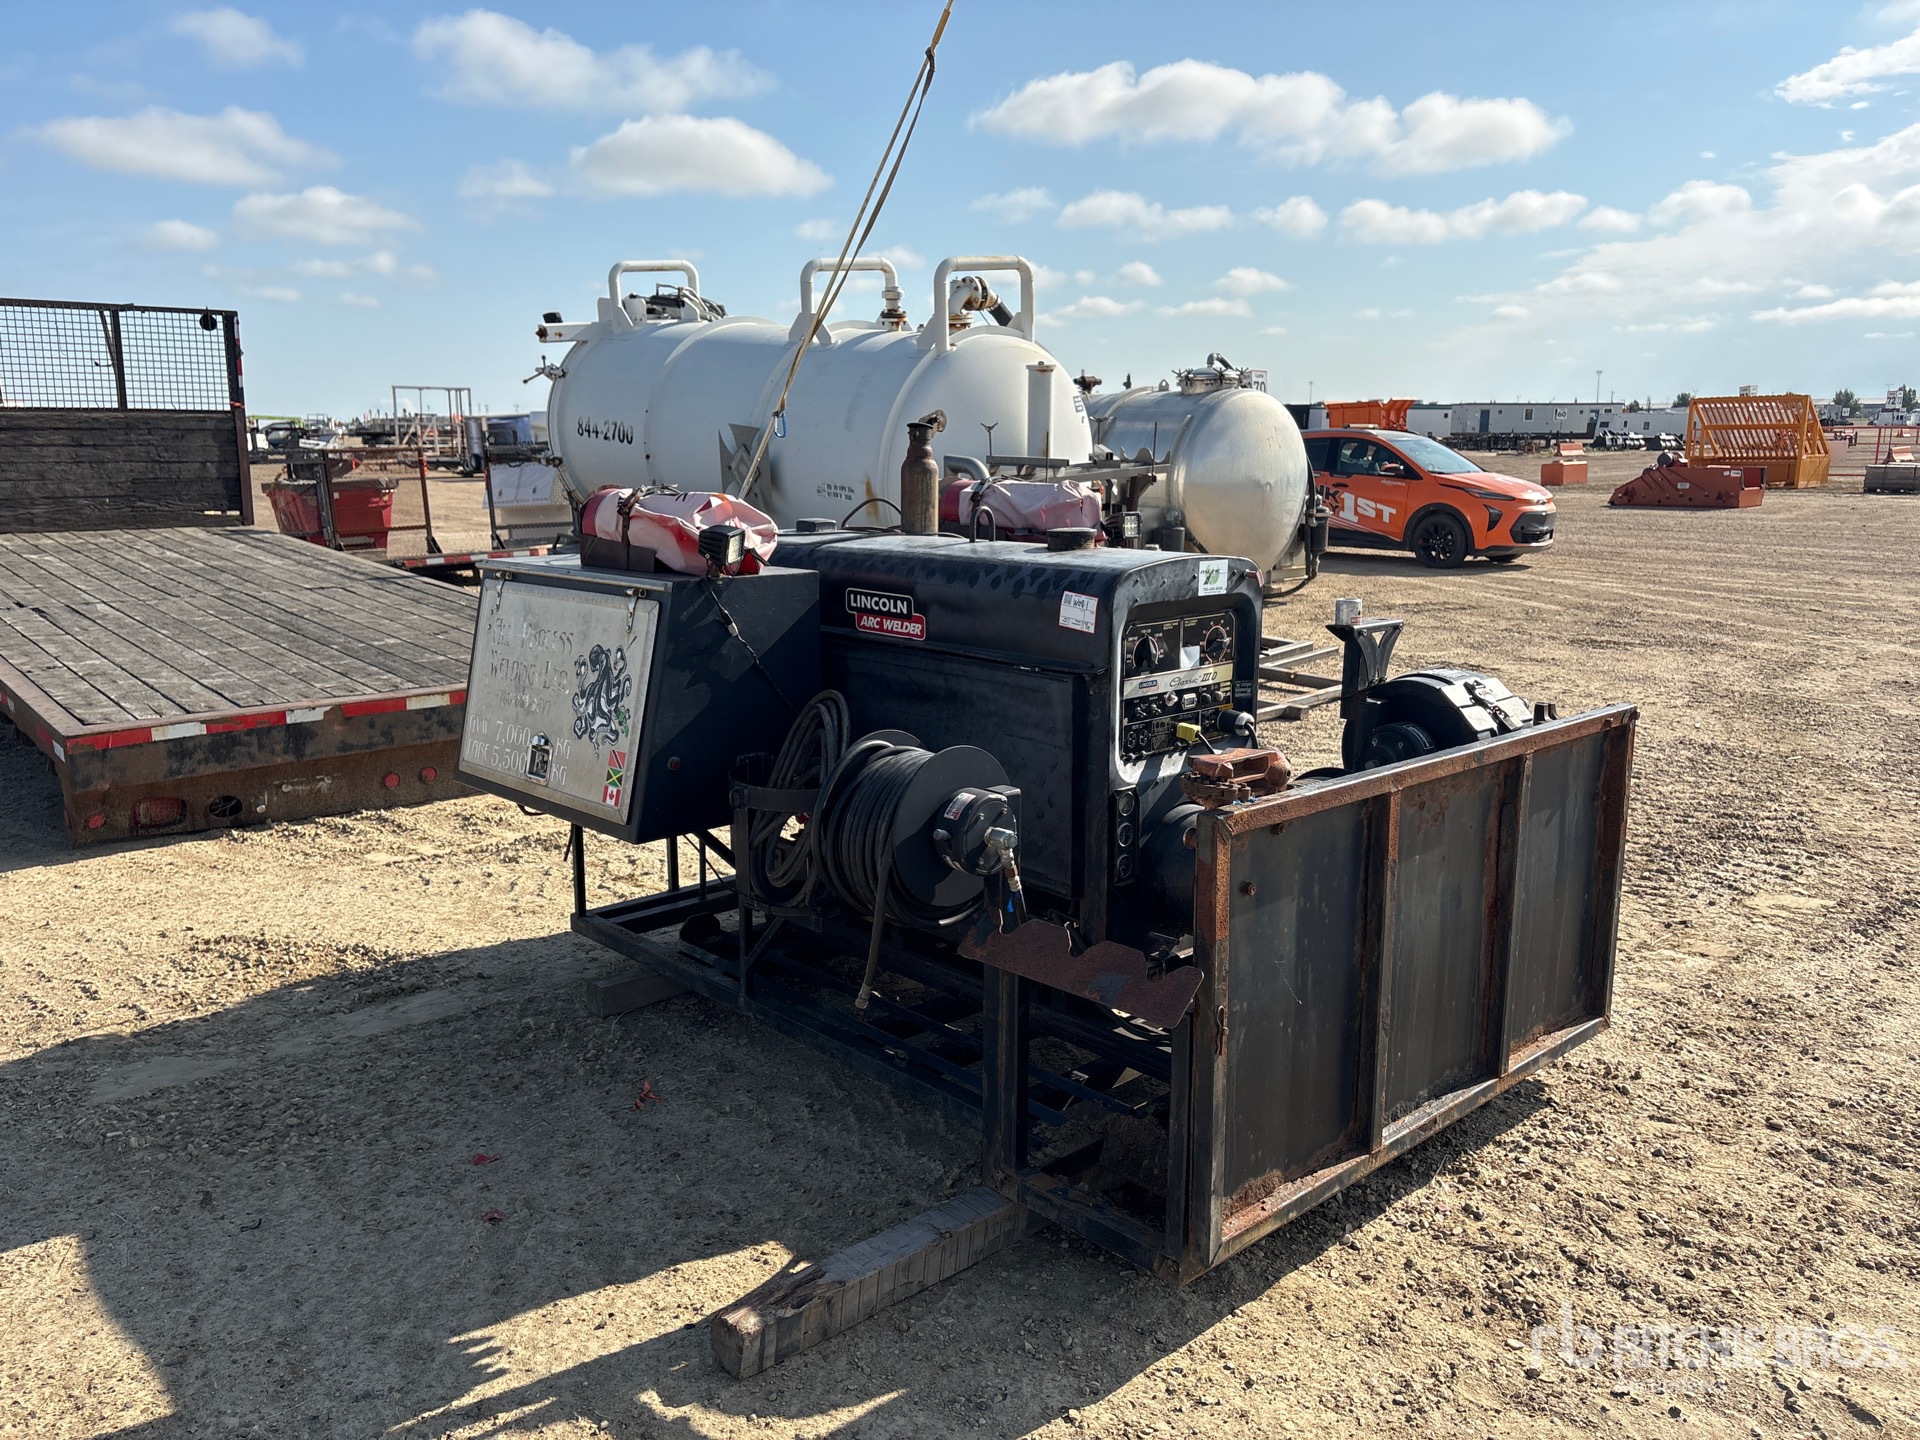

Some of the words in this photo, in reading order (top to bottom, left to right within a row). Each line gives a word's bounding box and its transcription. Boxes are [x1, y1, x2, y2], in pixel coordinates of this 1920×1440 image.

[1253, 380, 1266, 393] 70
[577, 416, 634, 445] 844-2700
[1338, 492, 1397, 523] 1ST
[850, 593, 908, 615] LINCOLN
[860, 615, 881, 629] ARC
[882, 618, 922, 636] WELDER
[1169, 676, 1198, 688] Classic
[496, 720, 531, 748] 7,000
[554, 737, 572, 760] KG
[466, 737, 491, 761] TARE
[491, 745, 528, 774] 5,500
[551, 763, 568, 786] KG
